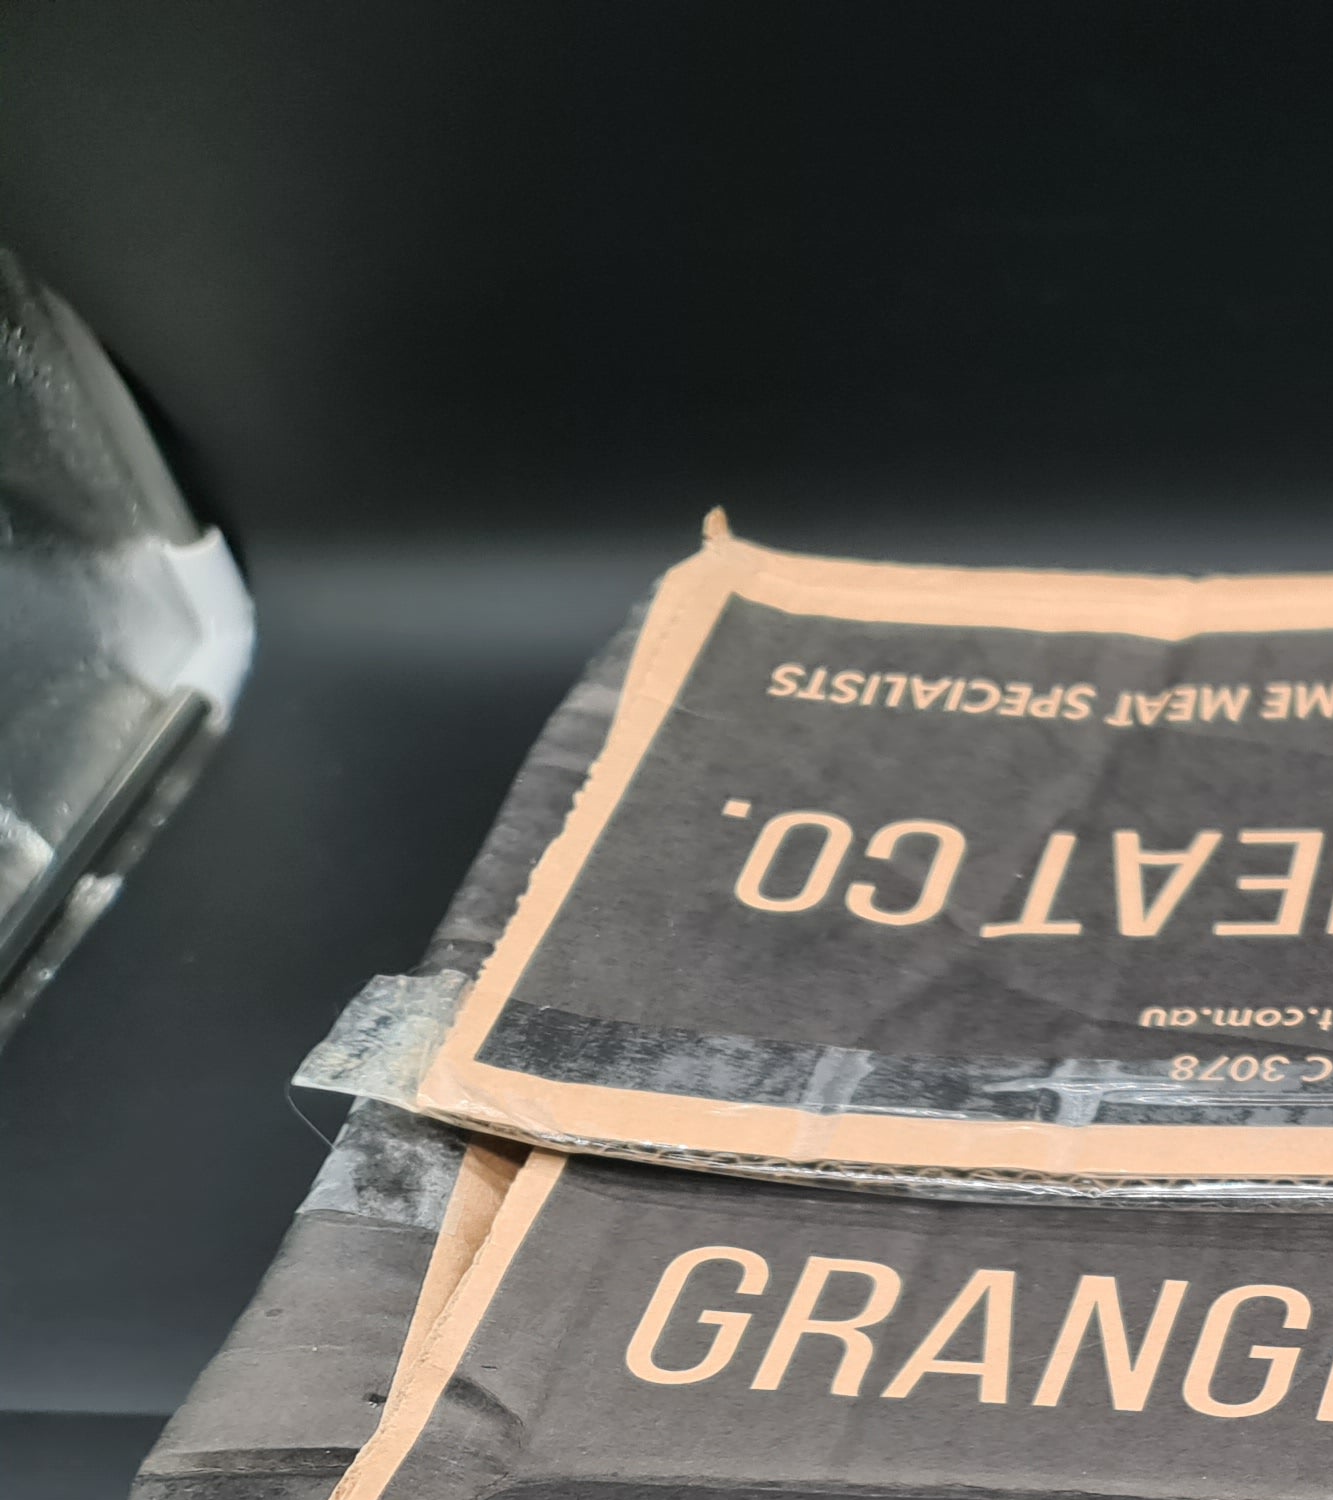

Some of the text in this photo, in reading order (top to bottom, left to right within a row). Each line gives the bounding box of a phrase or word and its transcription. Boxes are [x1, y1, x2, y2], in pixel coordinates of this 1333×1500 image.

[769, 663, 1097, 722] SPECIALISTS
[1106, 685, 1252, 729] MEAT
[724, 799, 967, 928] CO.
[1170, 1052, 1291, 1084] 3078
